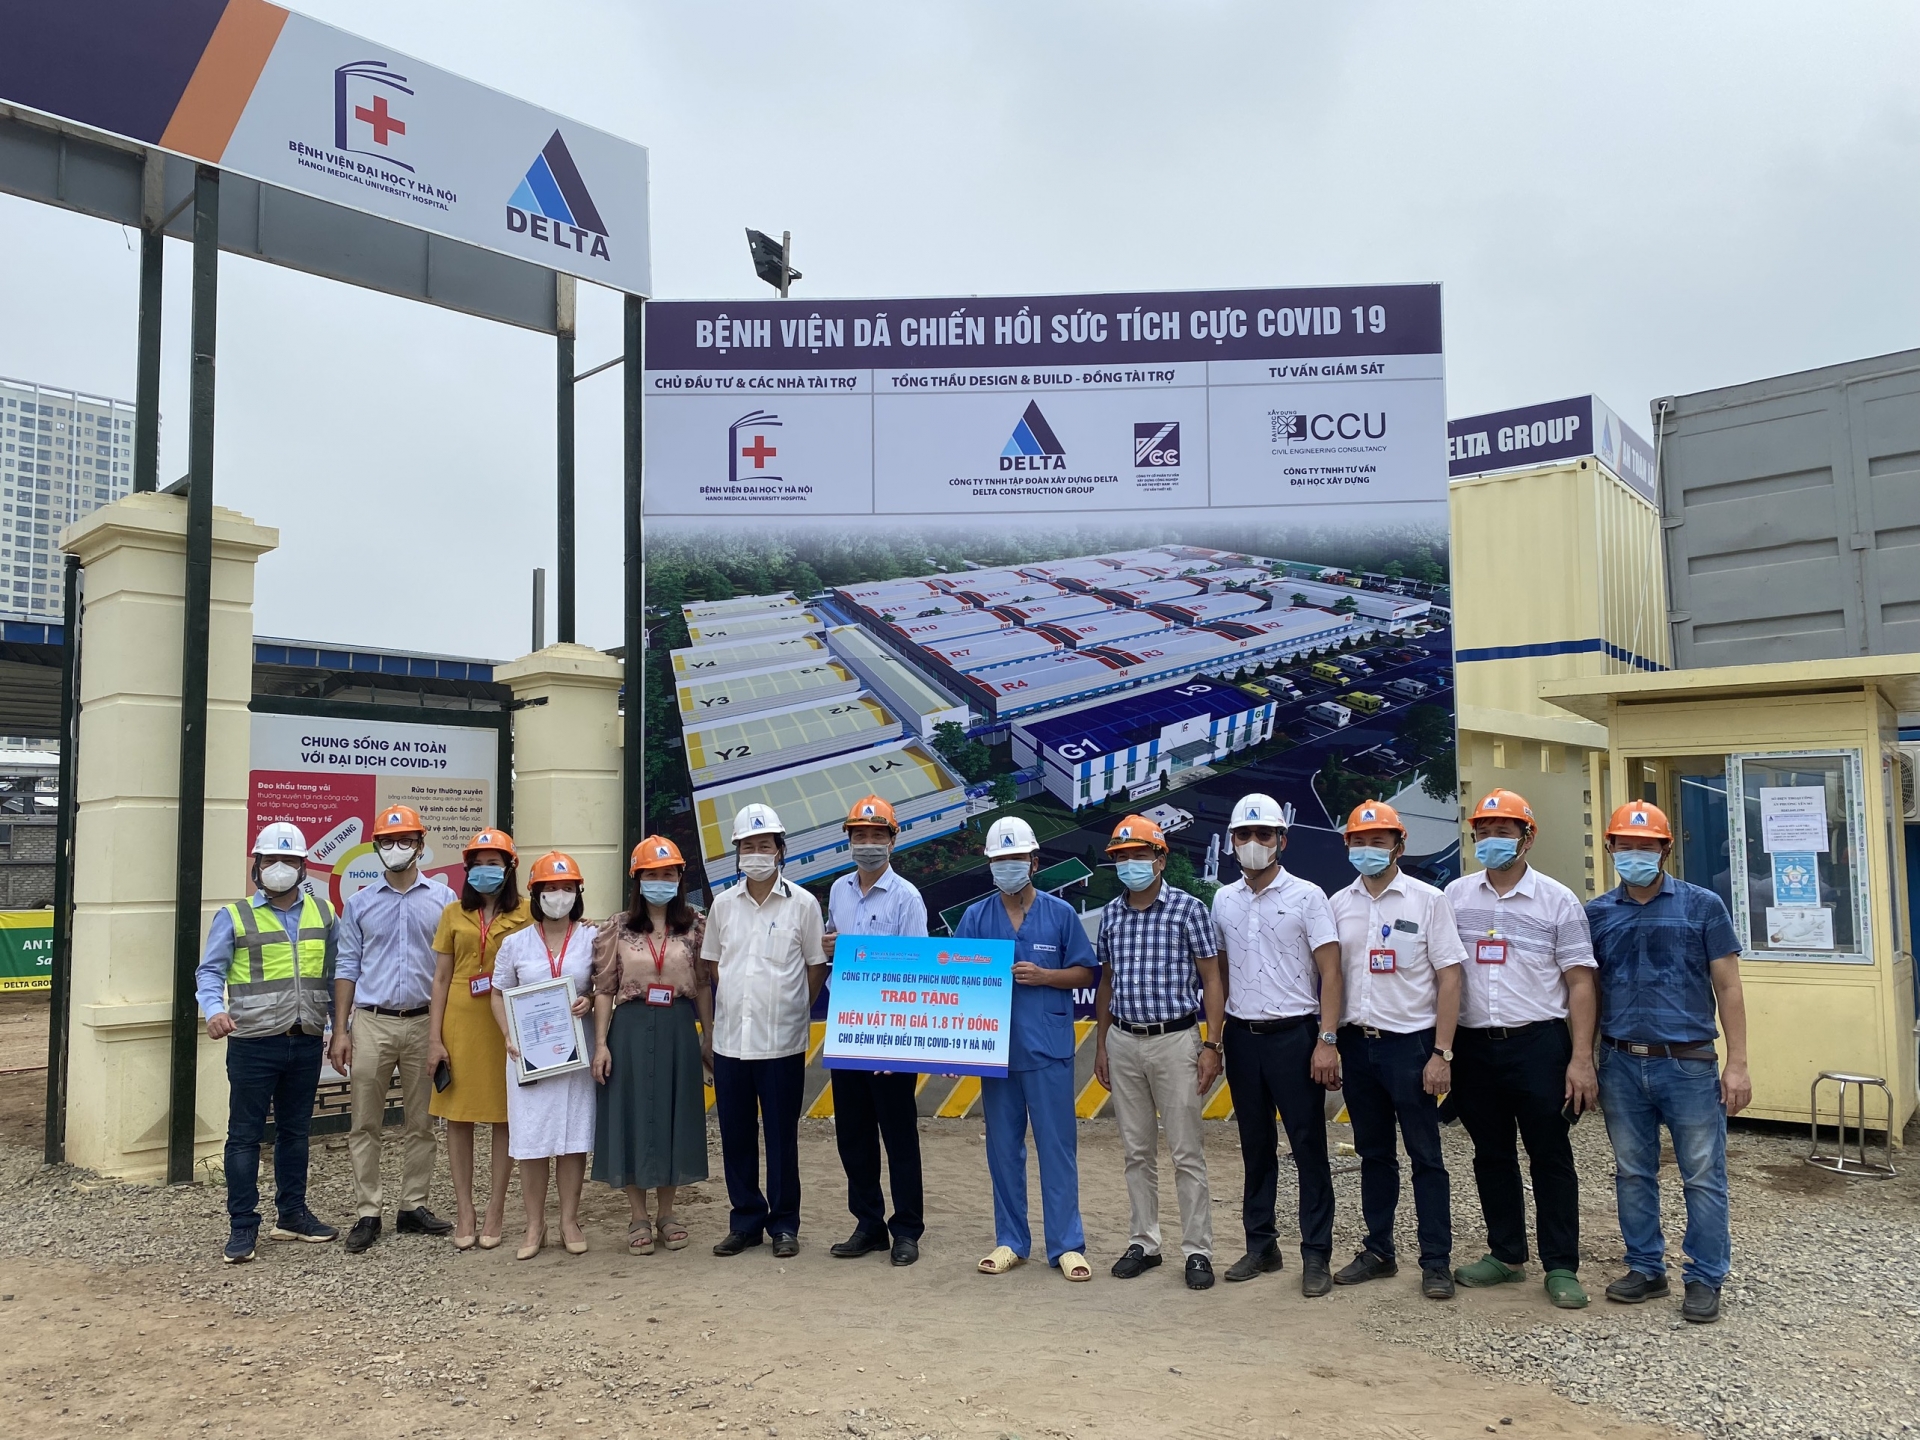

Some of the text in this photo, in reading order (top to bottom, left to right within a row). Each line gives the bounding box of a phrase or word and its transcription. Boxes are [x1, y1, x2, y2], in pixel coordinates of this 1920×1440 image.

[289, 140, 457, 204] BỆNH VIỆN ĐẠI HỌC Y HÀ NỘI
[298, 158, 449, 211] HANOI MEDICAL UNIVERSITY HOSPITAL
[506, 206, 610, 262] DELTA
[696, 305, 1386, 354] BỆNH VIỆN DÃ CHIẾN HỒI SỨC TÍCH CỰC COVID 19
[1269, 362, 1385, 378] TƯ VẤN GIÁM SÁT
[655, 375, 857, 390] CHỦ ĐẦU TƯ & CÁC NHÀ TÀI TRỢ
[892, 370, 1175, 387] TỔNG THẦU DESIGN & BUILD ĐỒNG TÀI TRỢ
[1310, 412, 1386, 440] CCU
[1448, 415, 1580, 460] ELTA GROUP
[1000, 455, 1066, 471] DELTA
[1284, 467, 1307, 475] CÔNG
[1359, 464, 1376, 473] VẤN
[949, 476, 972, 486] CÔNG
[1008, 476, 1024, 487] TẬP
[1025, 475, 1050, 485] ĐOÀN
[1051, 474, 1066, 484] XÂY
[1068, 475, 1092, 486] DỰNG
[1094, 475, 1118, 483] DELTA
[1290, 476, 1369, 487] ĐẠI HỌC XÂY DỰNG
[700, 485, 722, 494] BỆNH
[723, 485, 742, 494] VIỆN
[744, 486, 758, 494] ĐẠI
[759, 486, 777, 494] HỌC
[785, 485, 797, 493] HÀ
[798, 485, 812, 494] NỘI
[972, 486, 1095, 496] DELTA CONSTRUCTION GROUP
[909, 625, 938, 633] R10
[950, 649, 971, 658] R7
[1140, 650, 1164, 658] R3
[1001, 680, 1028, 691] R4
[700, 696, 730, 708] Y3
[1255, 709, 1264, 718] G1
[301, 736, 446, 754] CHUNG SỐNG AN TOÀN
[714, 745, 751, 761] Y2
[1058, 738, 1102, 760] G1
[301, 750, 447, 769] VỚI ĐẠI DỊCH COVID-19
[276, 782, 294, 790] khẩu
[297, 784, 316, 792] trang
[275, 813, 294, 822] khẩu
[314, 824, 357, 860] KHẨU TRANG
[349, 870, 378, 878] THÔNG
[22, 940, 42, 950] AN
[842, 970, 860, 982] CÔNG
[862, 973, 870, 982] TY
[872, 973, 880, 982] CP
[882, 971, 901, 982] BÓNG
[903, 972, 916, 983] ĐÈN
[918, 973, 939, 984] PHÍCH
[941, 974, 960, 985] NƯỚC
[962, 976, 981, 988] RẠNG
[881, 990, 959, 1006] TRAO TẶNG
[838, 1010, 998, 1032] HIỆN VẬT TRỊ GIÁ 1.8 TỶ ĐỒNG
[838, 1032, 853, 1043] CHO
[855, 1032, 874, 1046] BỆNH
[876, 1033, 893, 1047] VIỆN
[914, 1036, 925, 1049] TRỊ
[927, 1037, 961, 1049] COVID-19
[963, 1040, 968, 1049] Y
[969, 1037, 979, 1050] HÀ
[982, 1038, 995, 1053] NỘI
